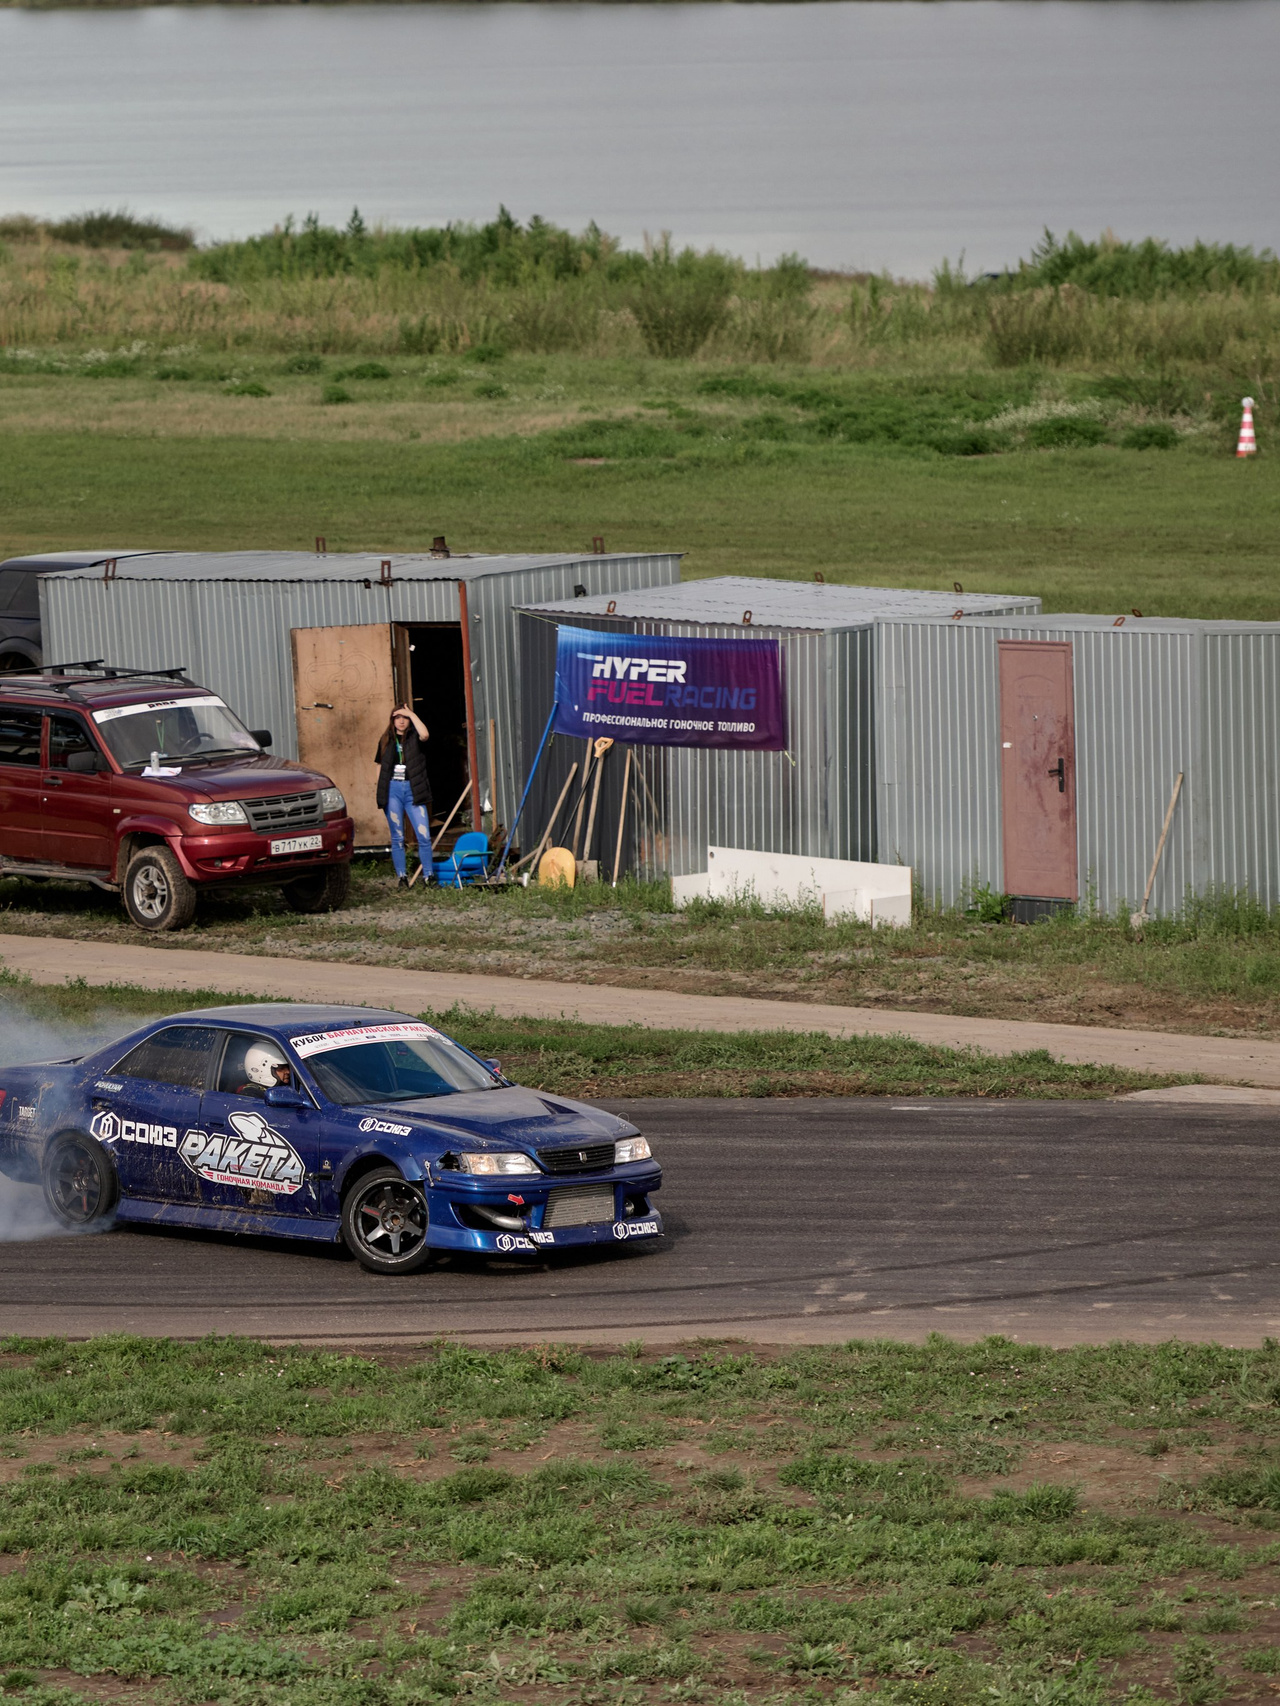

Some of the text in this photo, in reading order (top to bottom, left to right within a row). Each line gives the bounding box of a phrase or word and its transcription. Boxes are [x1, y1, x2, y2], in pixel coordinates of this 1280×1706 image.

[591, 655, 687, 684] HYPER
[587, 679, 757, 710] FUEL RACING
[582, 712, 756, 733] ПРОФЕССИОНАЛЬНОЕ ГОНОЧНОЕ ТОПЛИВО
[292, 1034, 326, 1048] КУБОК
[326, 1025, 402, 1039] БАРНАУЛЬСКОЙ
[18, 1105, 36, 1118] TARGET
[121, 1120, 178, 1148] СОЮЗ
[375, 1120, 413, 1136] СОЮЗ
[178, 1129, 304, 1185] РАКЕТА
[216, 1174, 286, 1191] ГОНОЧНАЯ КОМАНДА
[628, 1221, 659, 1235] СОЮЗ
